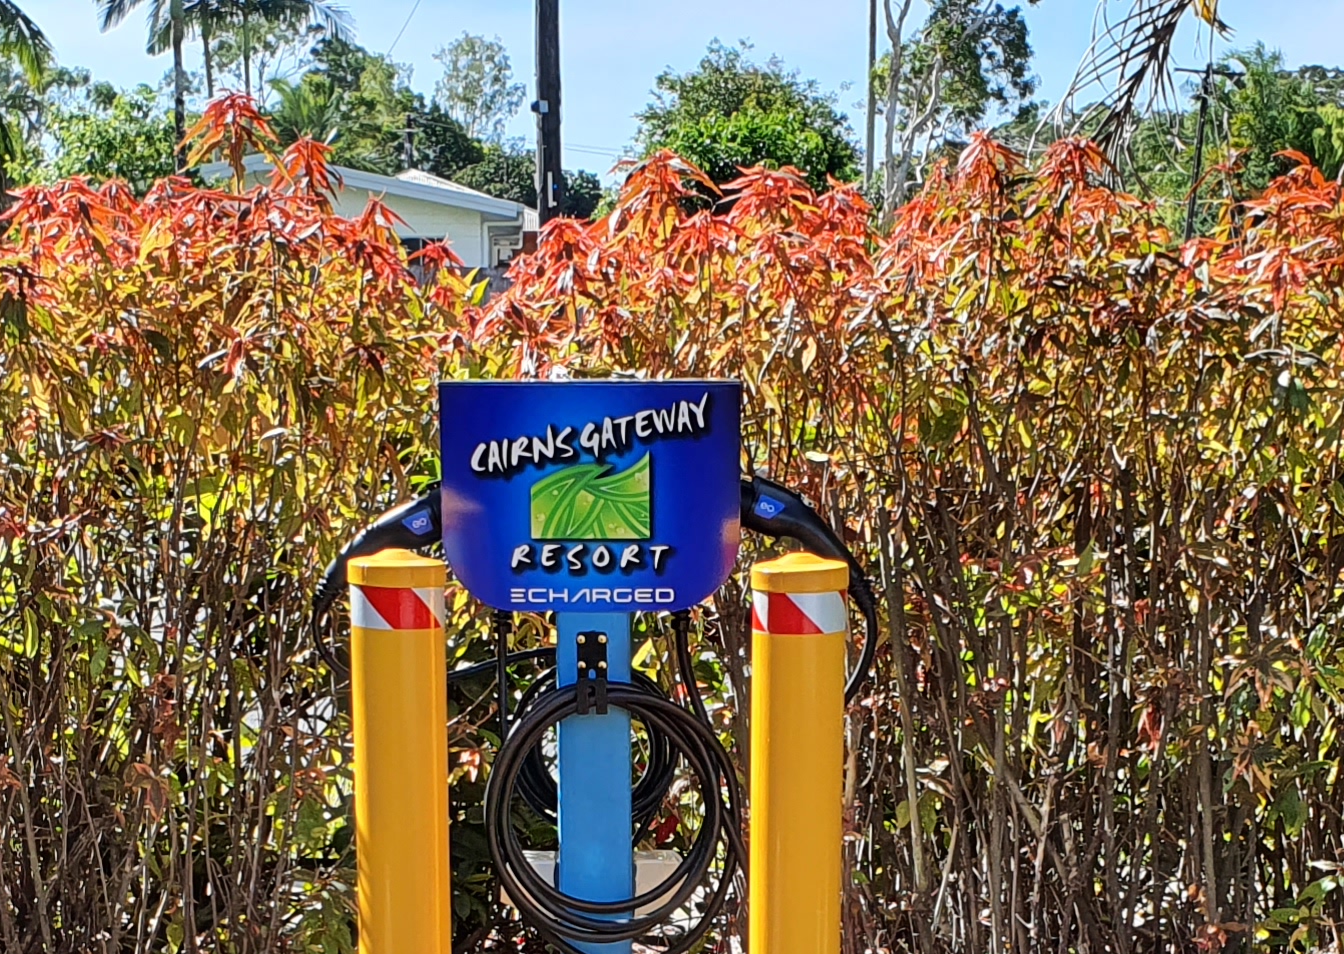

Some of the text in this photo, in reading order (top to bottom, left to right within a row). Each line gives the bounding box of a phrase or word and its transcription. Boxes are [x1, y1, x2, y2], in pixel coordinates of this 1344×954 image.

[471, 392, 708, 473] CAIRNS GATEWAY
[511, 544, 669, 570] RESORT
[510, 588, 675, 603] ECHARGED
